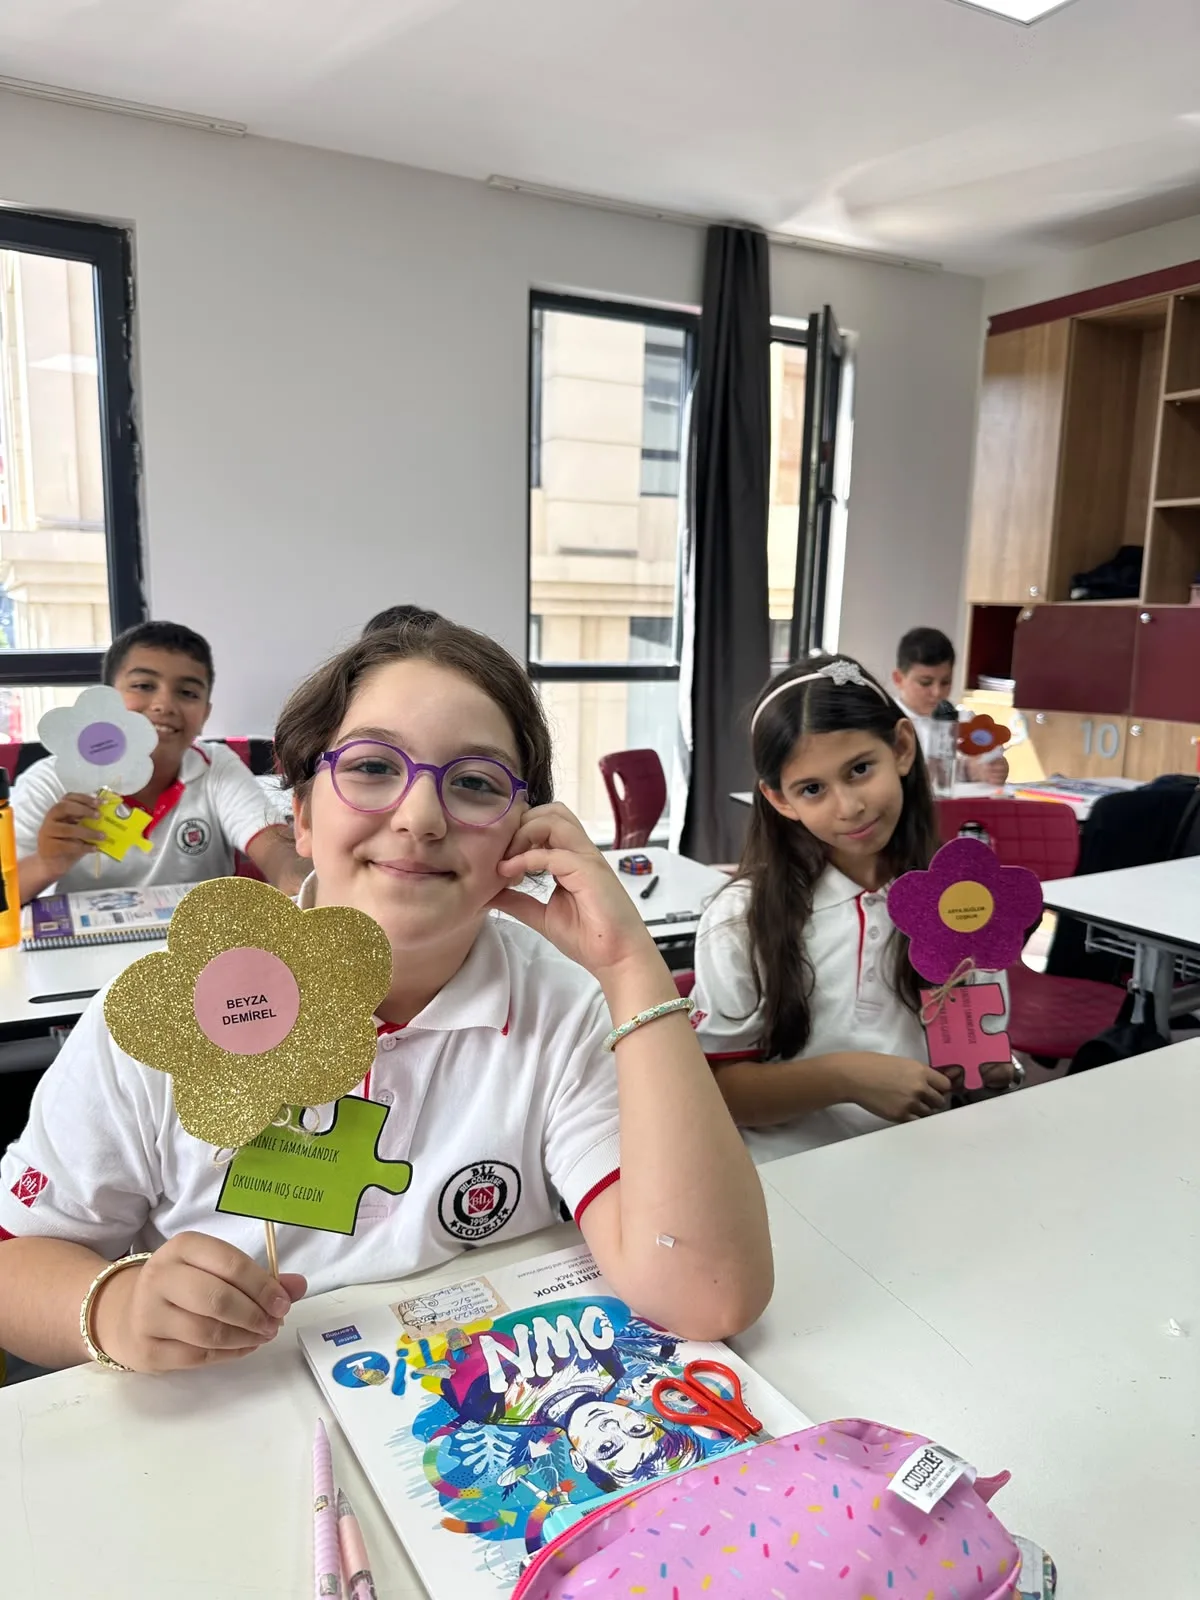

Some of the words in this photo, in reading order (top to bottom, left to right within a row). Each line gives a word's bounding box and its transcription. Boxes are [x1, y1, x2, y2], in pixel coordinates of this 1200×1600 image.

[1081, 720, 1120, 760] 10
[226, 994, 268, 1009] BEYZA
[222, 1008, 277, 1025] DEMİREL
[278, 1139, 340, 1163] TAMAMLANDIK
[232, 1173, 273, 1193] OKULUNA
[274, 1182, 290, 1199] HOŞ
[292, 1185, 324, 1203] GELDİN
[554, 1272, 574, 1282] PACK
[533, 1282, 567, 1298] BOOK
[902, 1451, 943, 1491] MUGGLE
